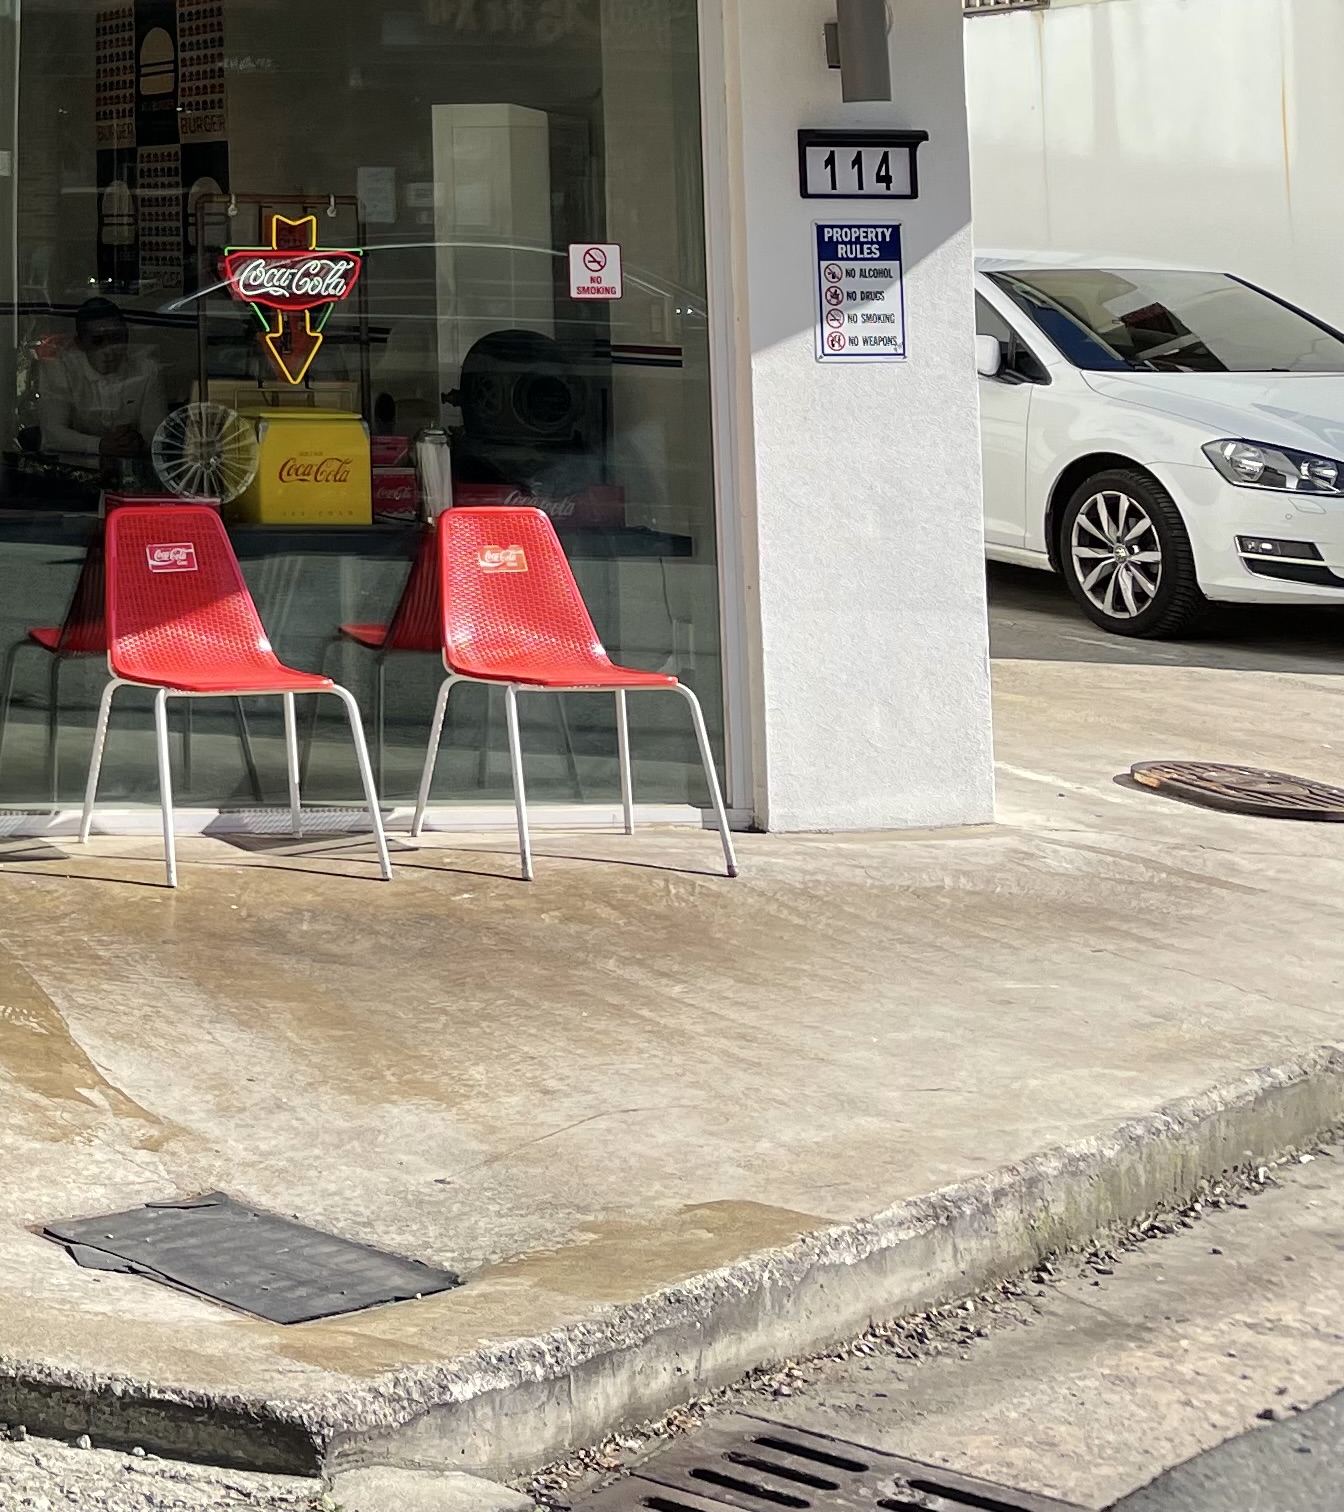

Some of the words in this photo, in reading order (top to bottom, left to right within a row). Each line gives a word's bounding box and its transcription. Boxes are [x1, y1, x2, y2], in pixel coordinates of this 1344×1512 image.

[823, 150, 894, 191] 114
[824, 228, 892, 242] PROPERTY
[837, 244, 880, 258] RULES
[845, 268, 856, 278] NO
[859, 268, 893, 279] ALCOHOL
[590, 276, 602, 285] NO
[576, 287, 617, 295] SMOKING
[846, 291, 857, 301] NO
[860, 291, 885, 301] DRUGS
[847, 314, 858, 324] NO
[860, 314, 895, 324] SMOKING
[848, 336, 859, 346] NO
[862, 336, 898, 346] WEAPONS
